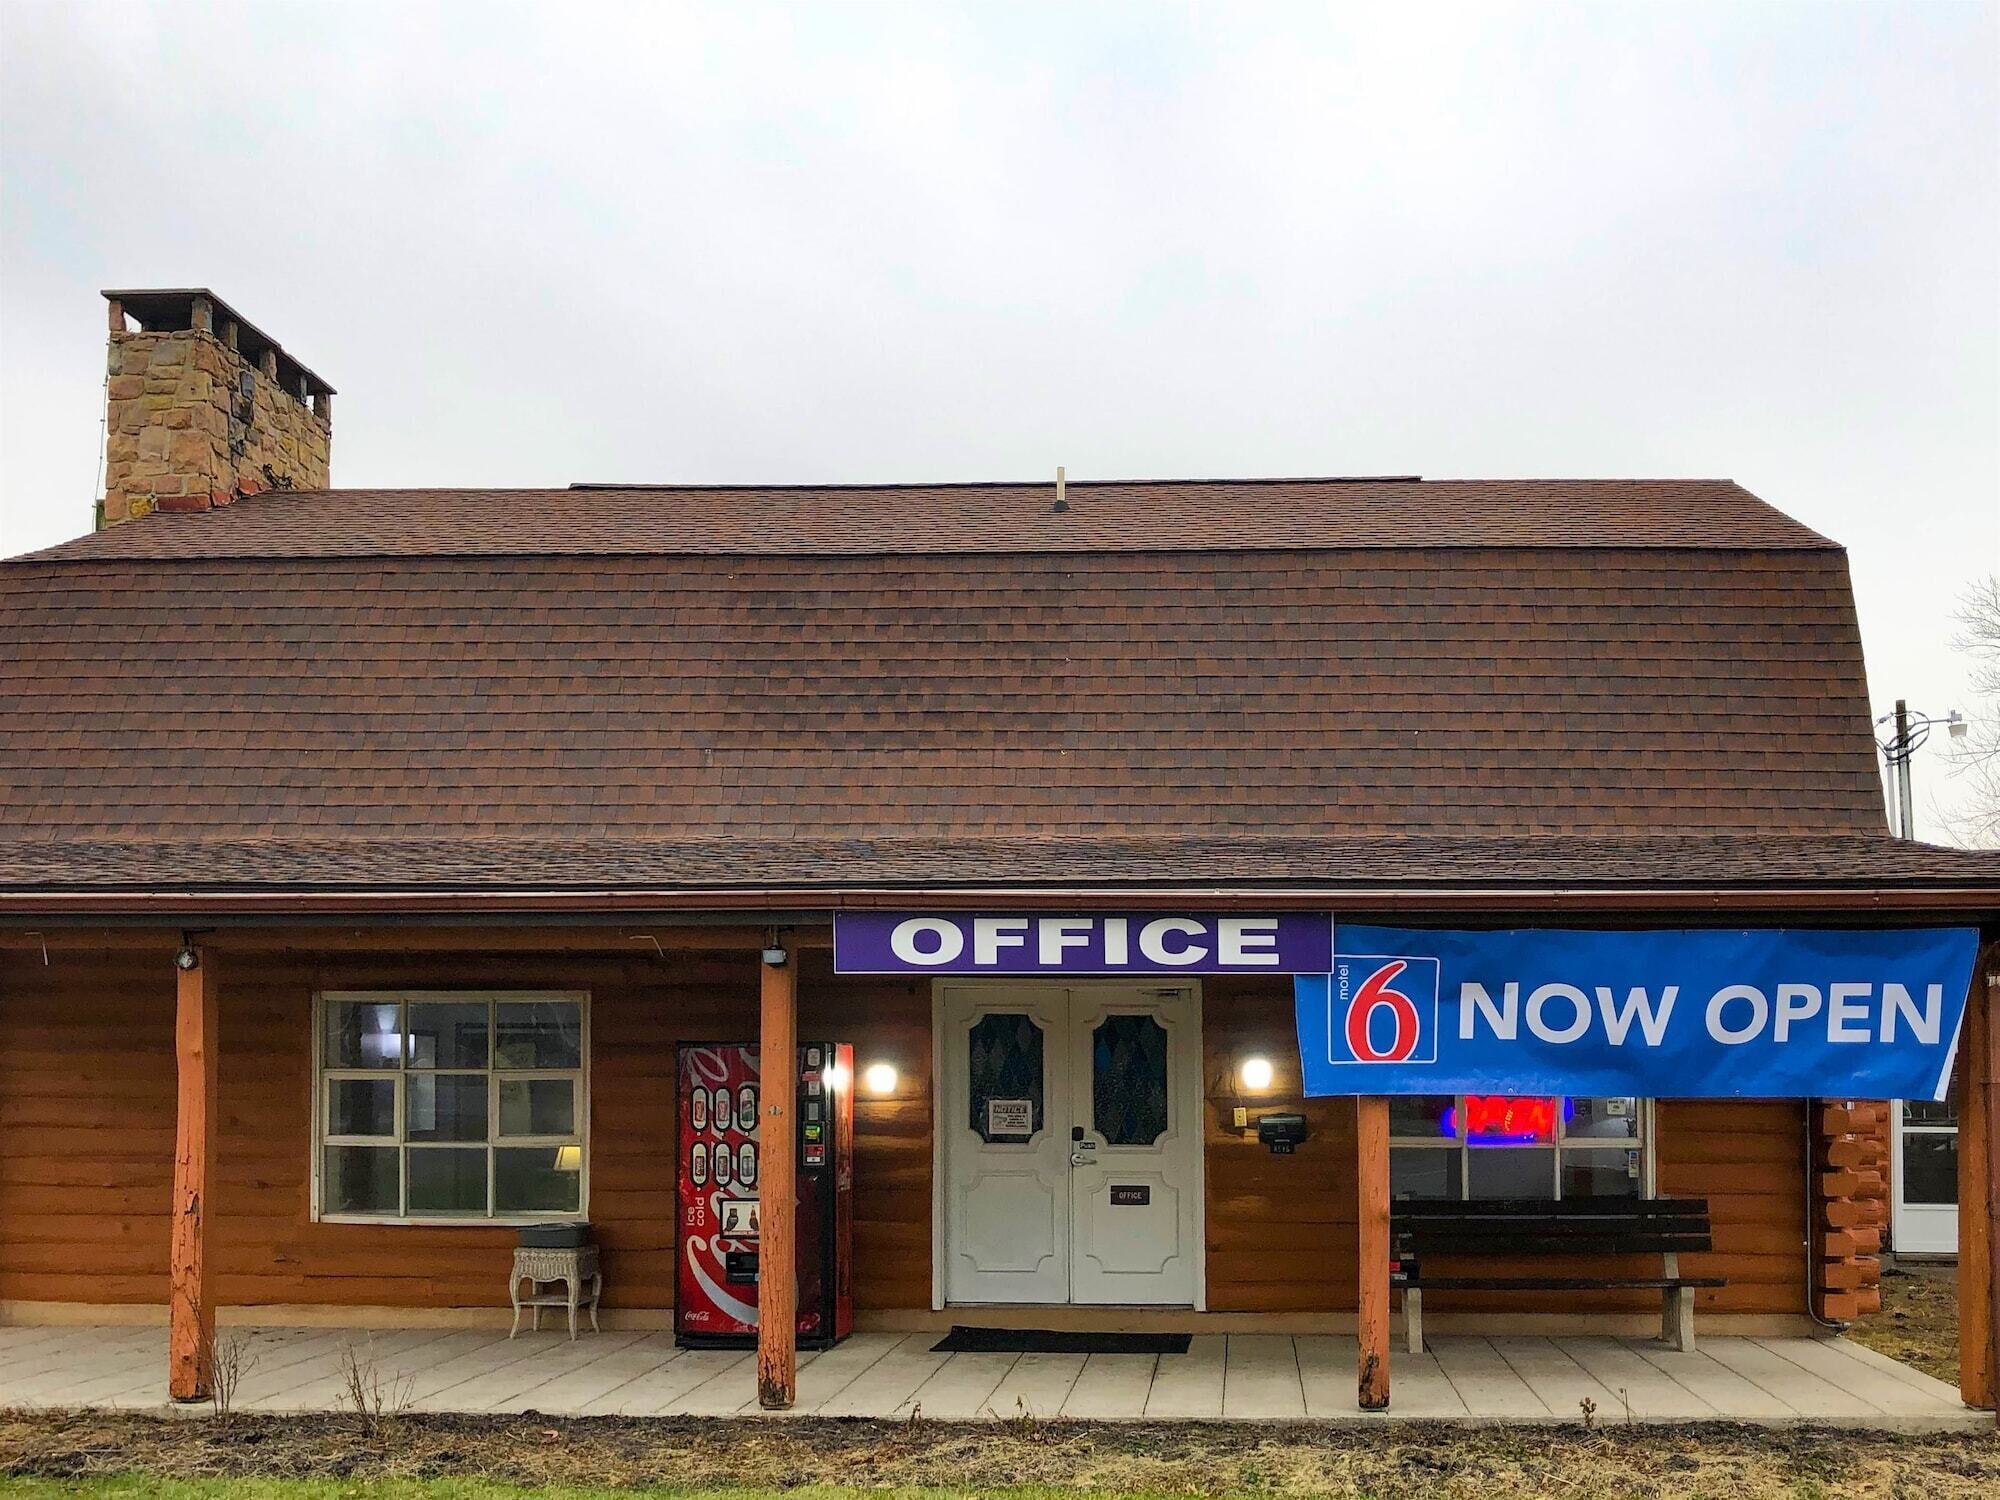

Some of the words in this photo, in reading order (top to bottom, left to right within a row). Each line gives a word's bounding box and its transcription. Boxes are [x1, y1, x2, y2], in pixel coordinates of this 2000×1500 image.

[890, 917, 1280, 966] OFFICE
[1337, 964, 1349, 1000] motel
[1345, 959, 1420, 1064] 6
[1458, 981, 1680, 1047] NOW
[1705, 983, 1943, 1045] OPEN
[994, 1104, 1026, 1113] NOTICE
[695, 1196, 705, 1227] cold
[1118, 1191, 1143, 1200] OFFICE
